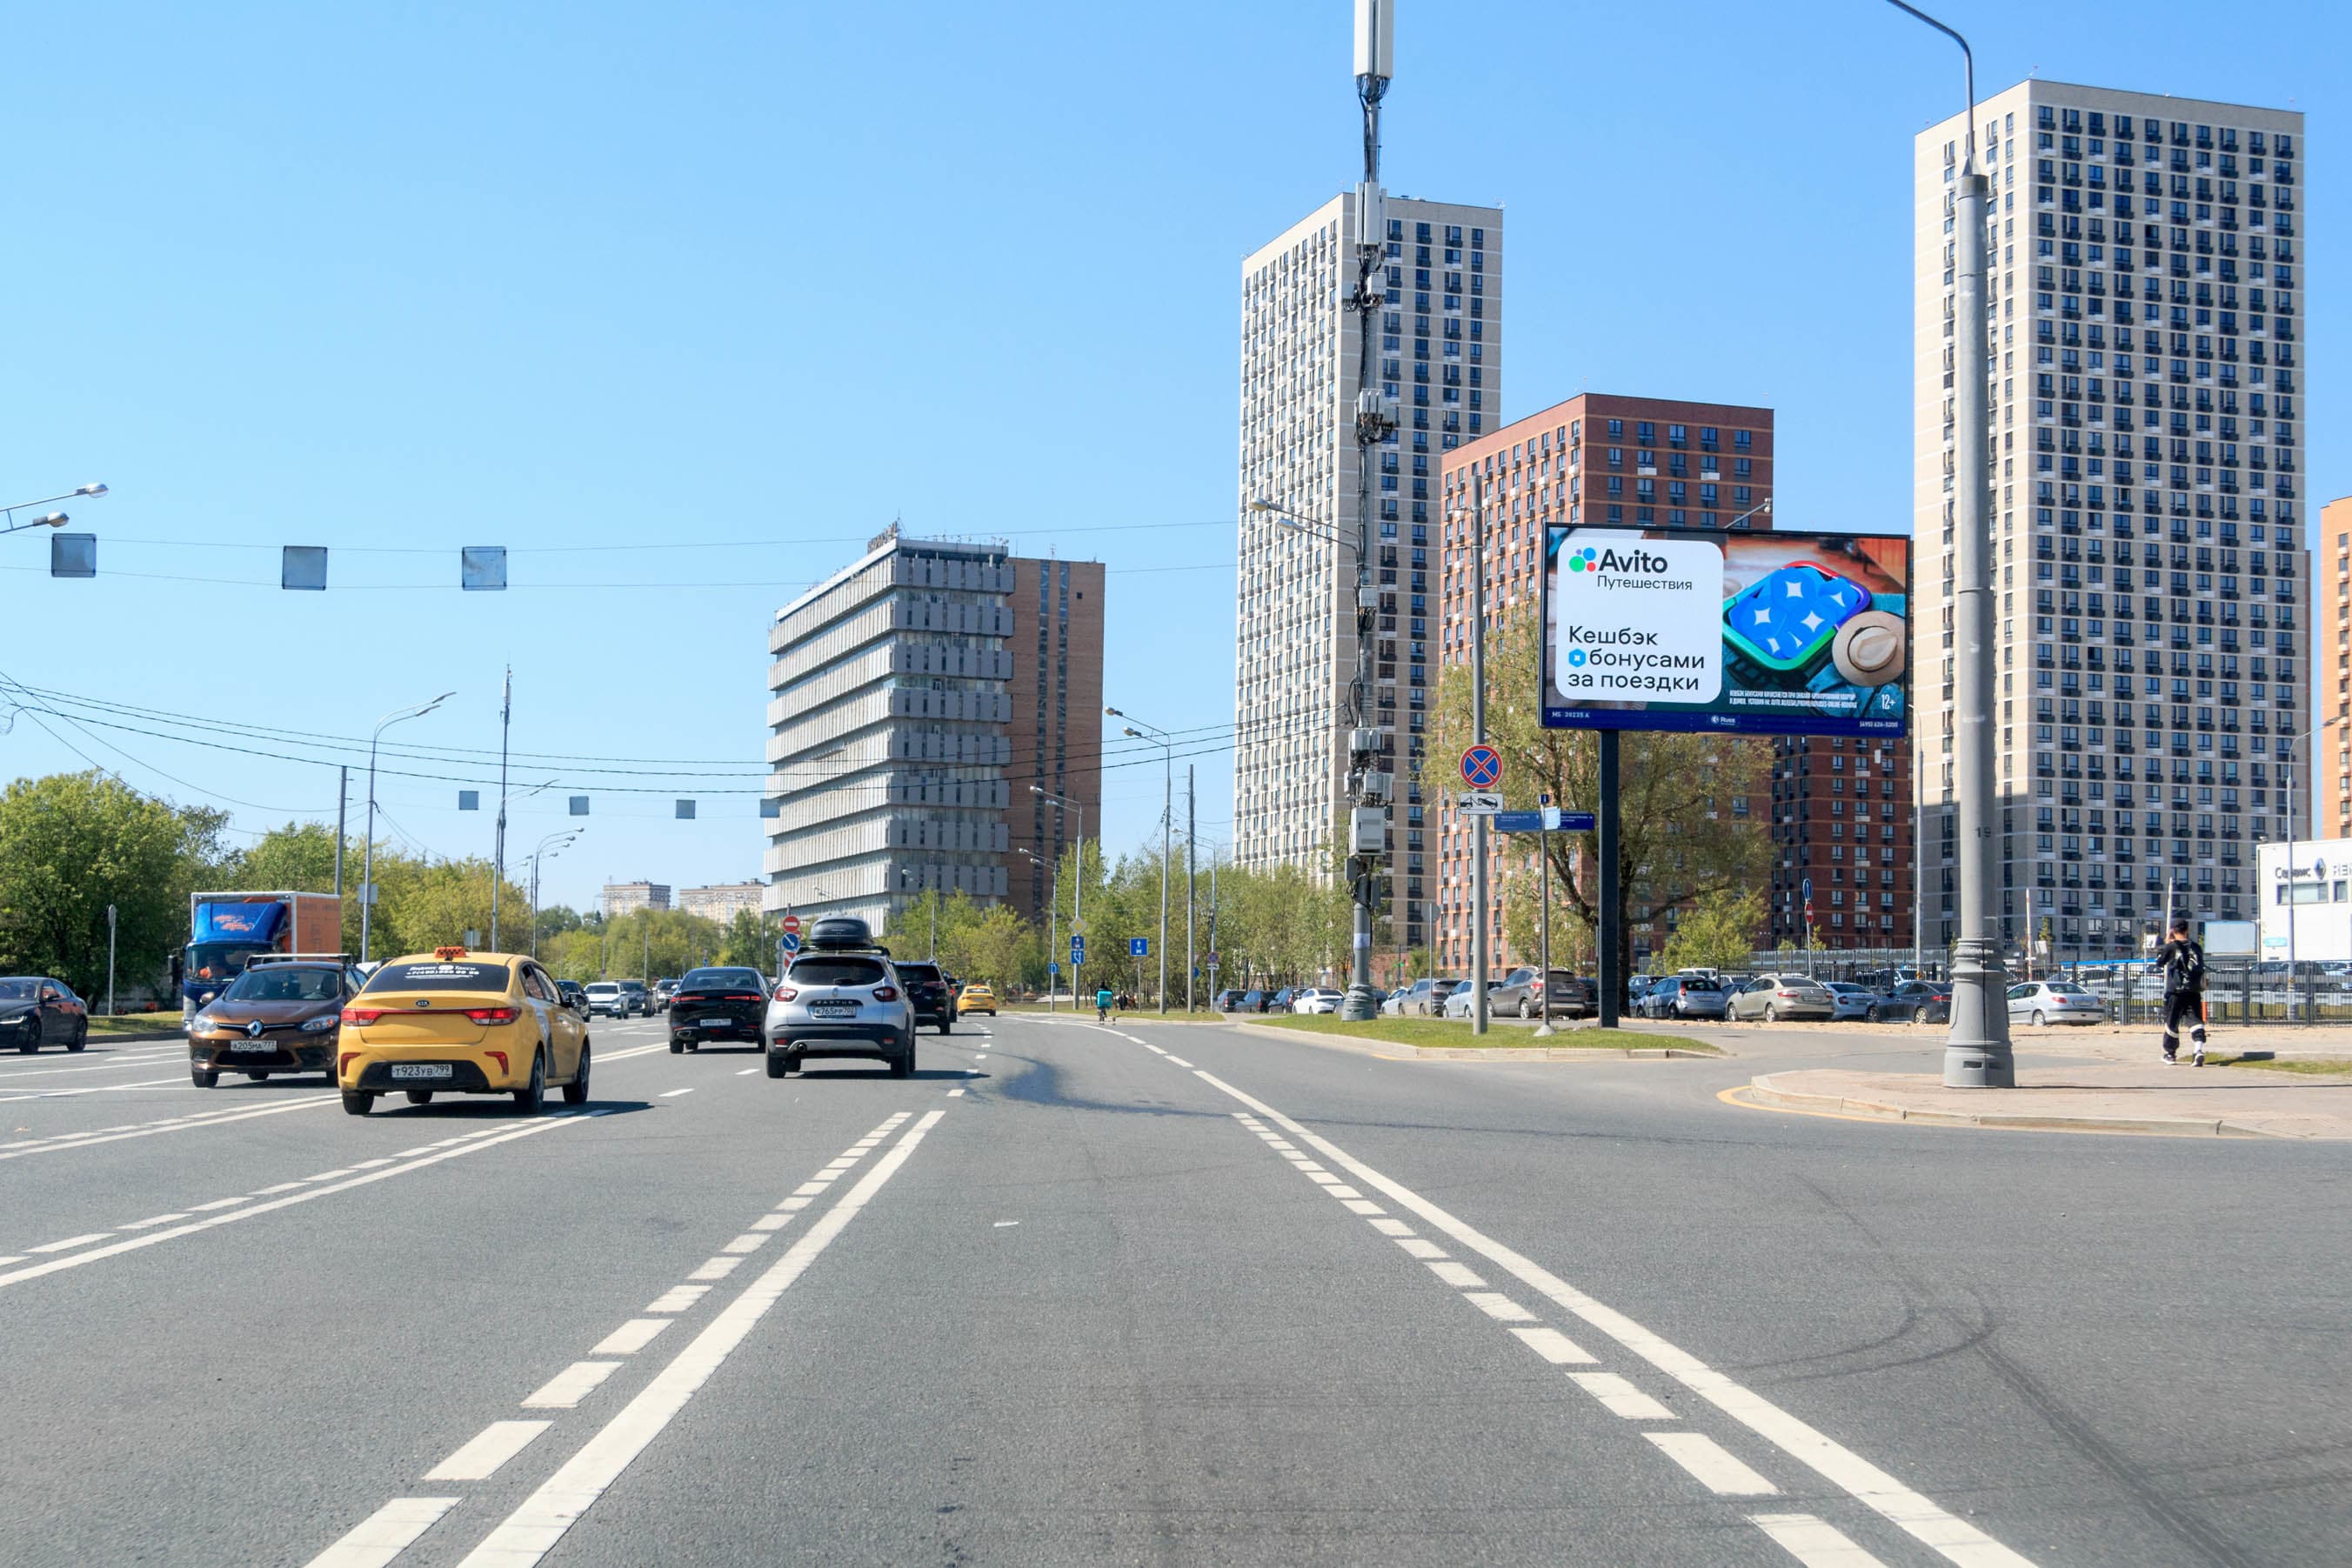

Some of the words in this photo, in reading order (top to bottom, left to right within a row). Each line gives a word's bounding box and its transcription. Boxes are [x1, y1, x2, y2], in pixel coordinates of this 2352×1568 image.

[1599, 549, 1667, 573] Avito
[1597, 575, 1693, 591] Путешествия
[1569, 625, 1659, 645] Кешбэк
[1589, 648, 1705, 671] бонусами
[1567, 674, 1594, 687] за
[1600, 675, 1699, 692] поездки
[1881, 694, 1896, 710] 12+
